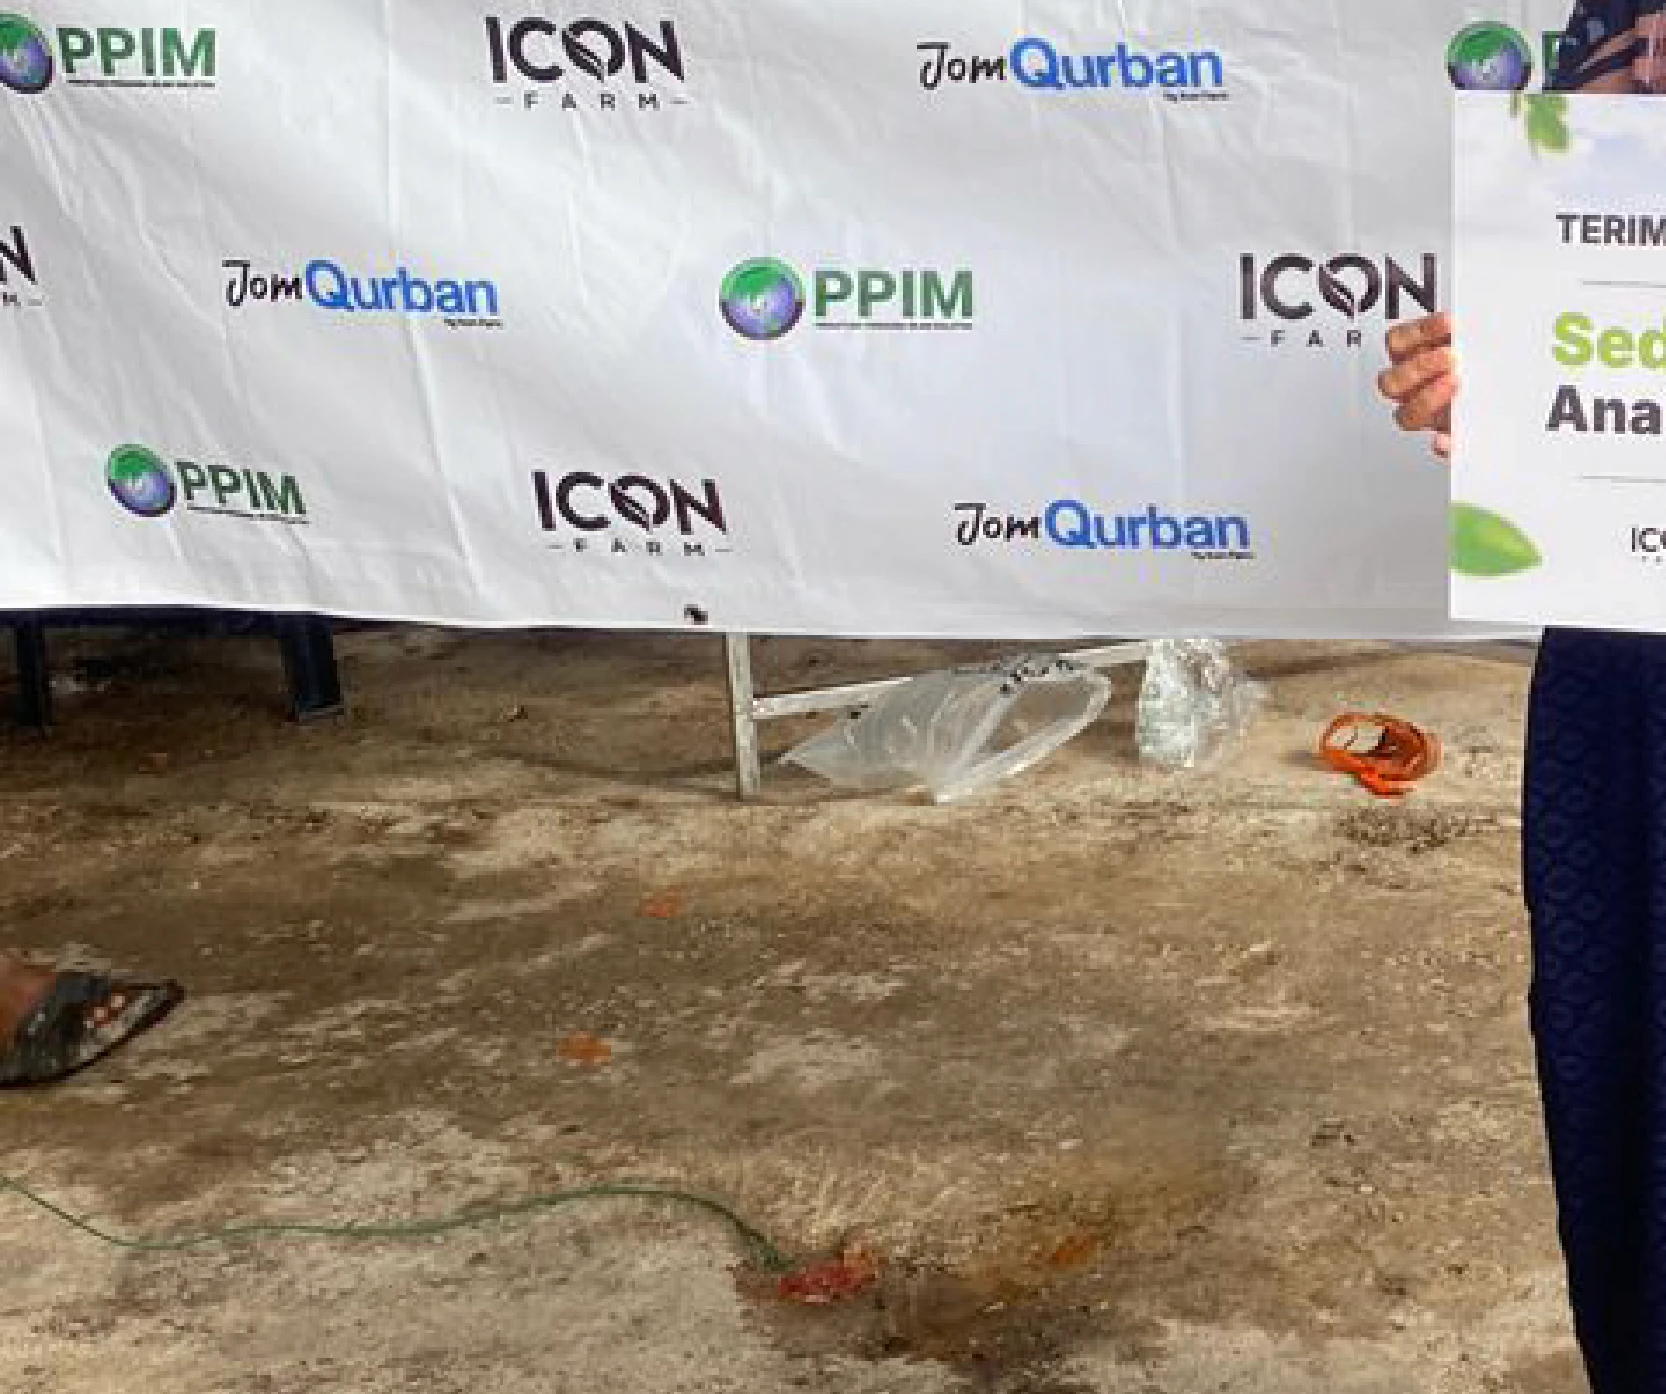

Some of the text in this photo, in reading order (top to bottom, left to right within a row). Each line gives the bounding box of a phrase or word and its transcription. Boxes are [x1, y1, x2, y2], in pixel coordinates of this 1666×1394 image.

[58, 28, 215, 76] PPIM
[486, 17, 684, 82] ICON
[815, 271, 973, 319] PPIM
[1240, 253, 1437, 319] ICON
[174, 462, 307, 515] PPIM
[535, 472, 727, 534] ICON
